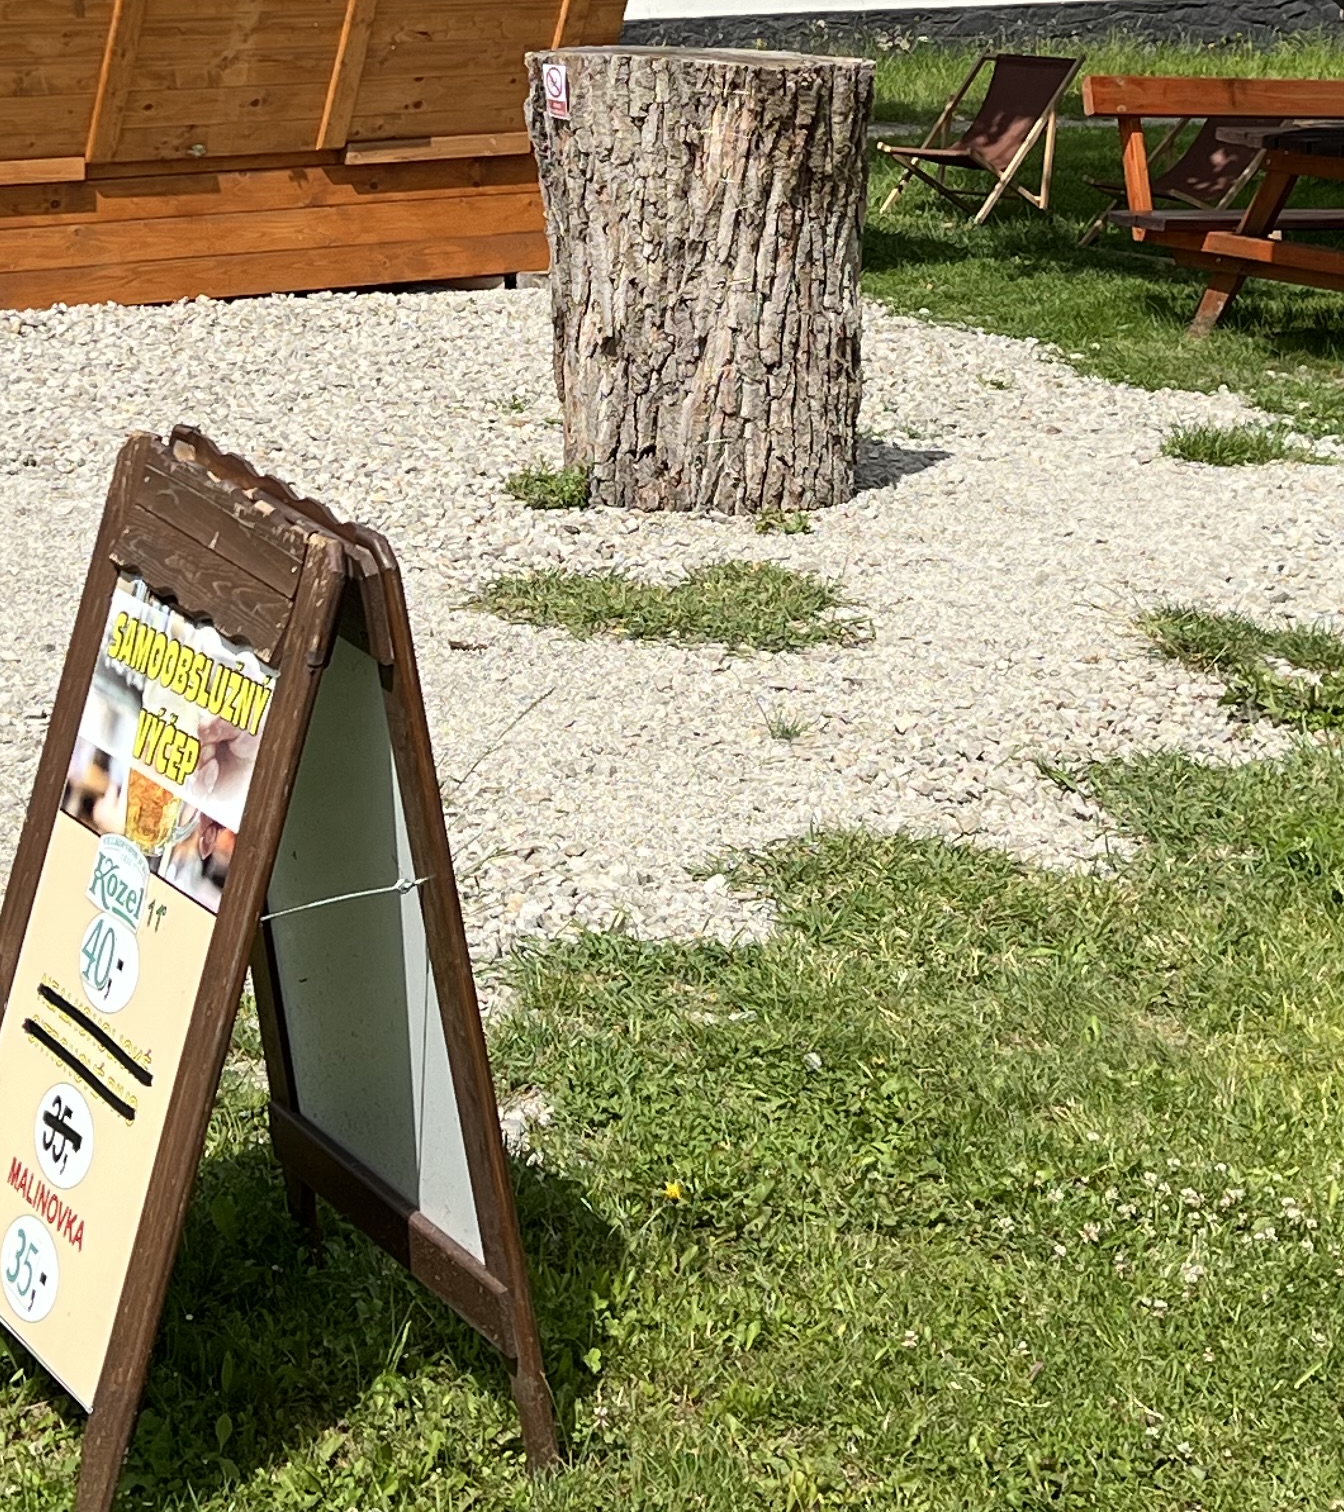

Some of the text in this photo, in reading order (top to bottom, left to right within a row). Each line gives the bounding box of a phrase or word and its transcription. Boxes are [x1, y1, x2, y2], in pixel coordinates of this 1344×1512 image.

[107, 610, 273, 737] SAMOOBSLUŽNÝ
[131, 706, 202, 786] VÝČEP
[88, 850, 145, 929] Kozel
[6, 1156, 86, 1253] MALINOVKA
